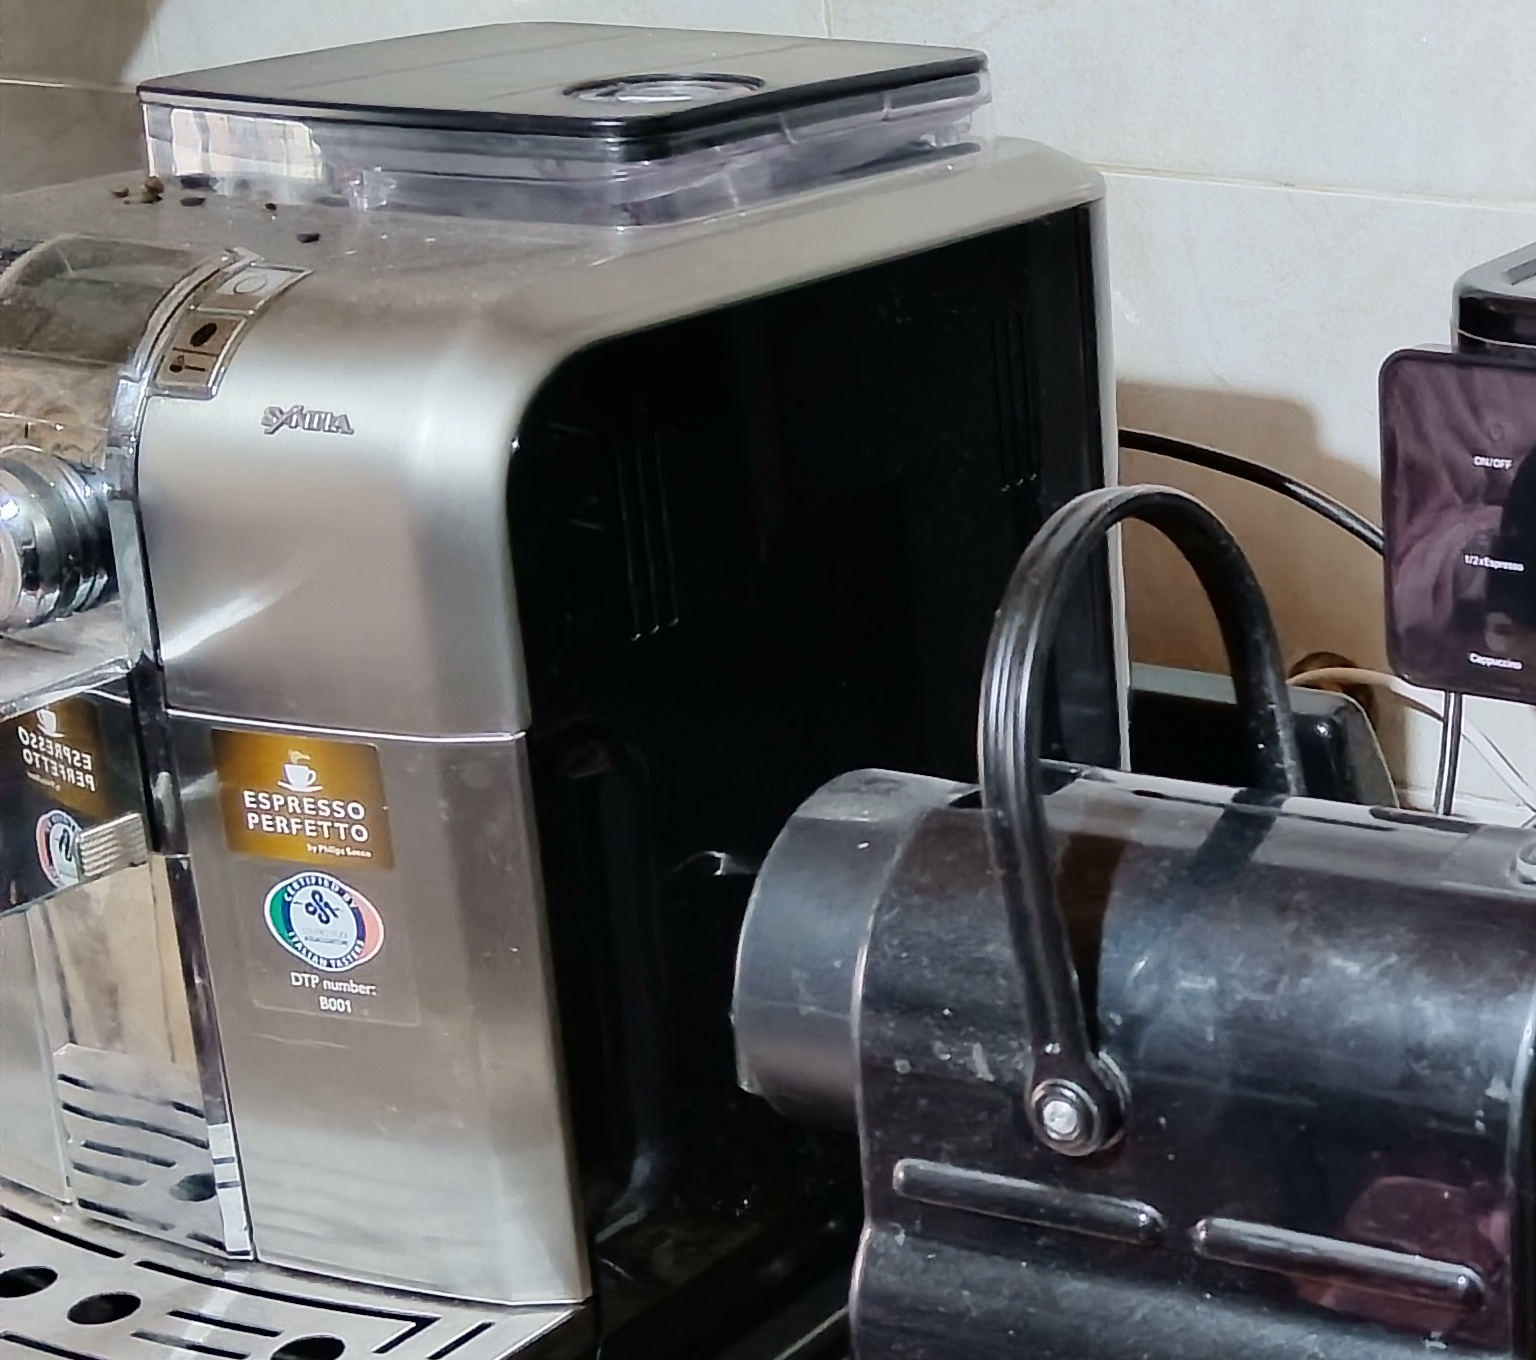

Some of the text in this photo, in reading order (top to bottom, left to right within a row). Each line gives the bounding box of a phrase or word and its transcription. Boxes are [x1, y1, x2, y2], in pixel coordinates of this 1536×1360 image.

[243, 790, 366, 820] ESPRESSO
[247, 812, 369, 842] PERFETTO
[290, 971, 377, 996] DTP number:
